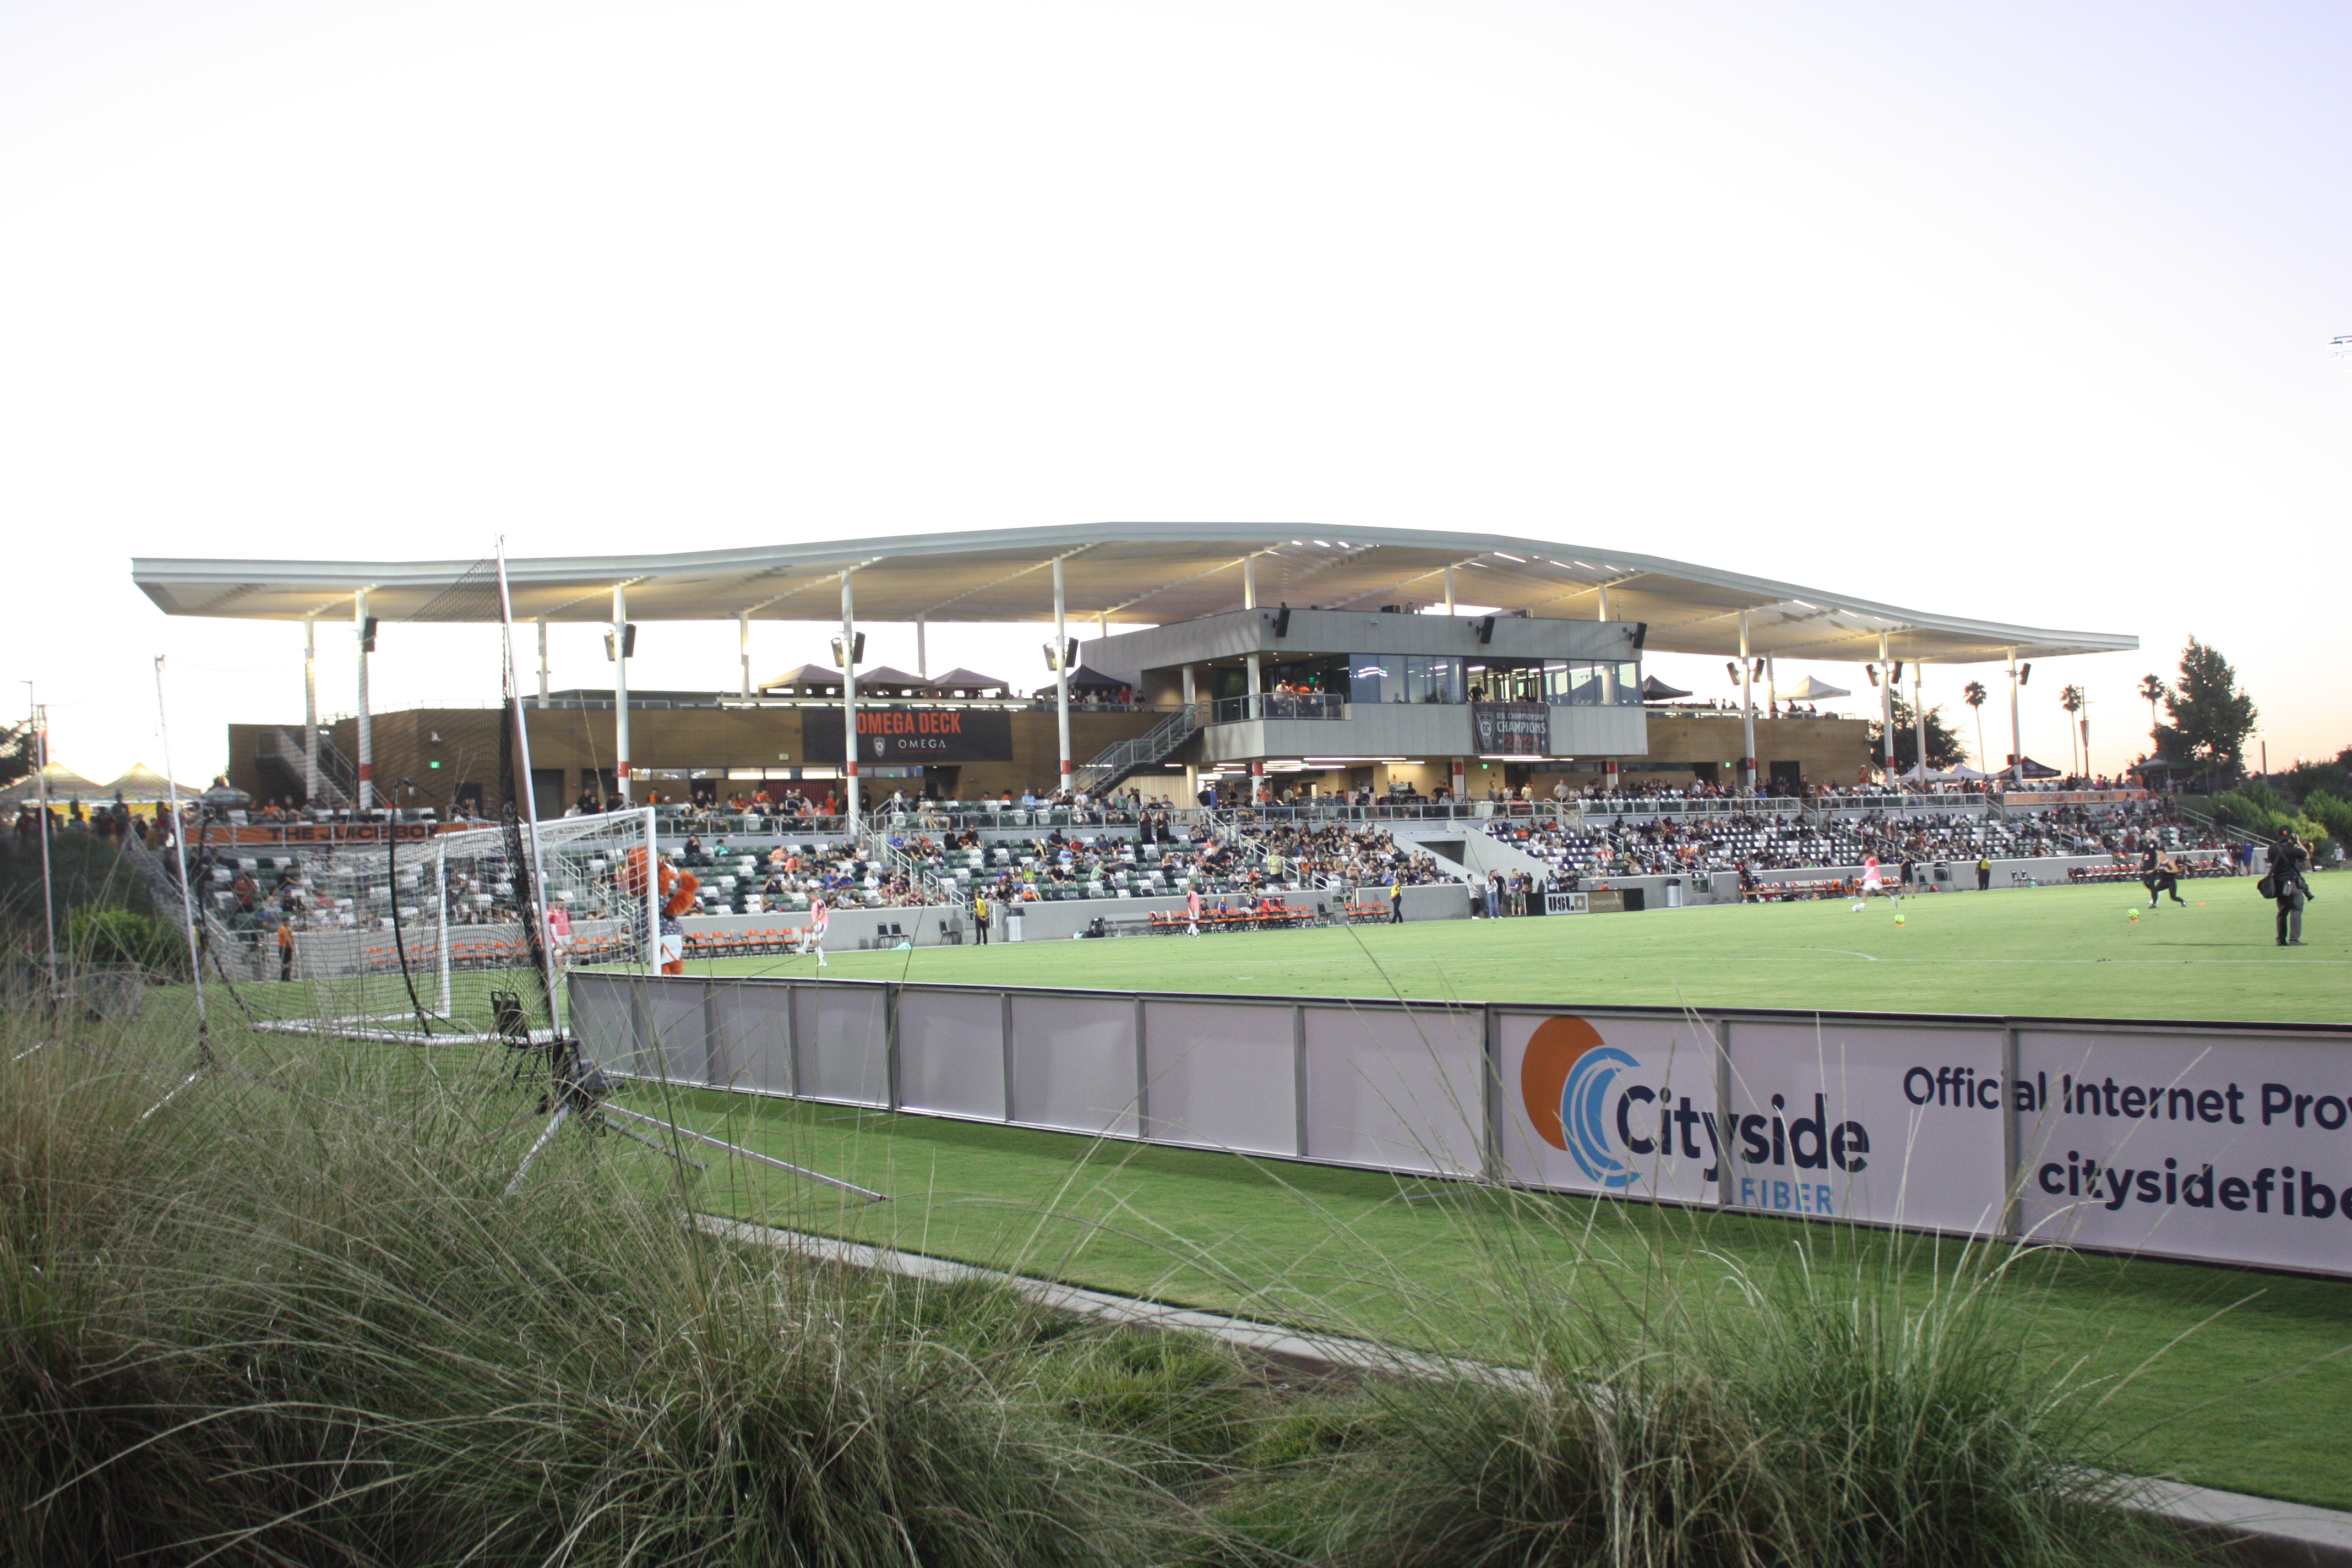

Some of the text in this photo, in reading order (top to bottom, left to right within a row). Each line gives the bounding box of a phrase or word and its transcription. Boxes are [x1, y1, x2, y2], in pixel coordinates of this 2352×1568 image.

[857, 712, 961, 734] OMEGA DECK
[1508, 712, 1545, 721] CHAMPIONSHIP
[1497, 721, 1546, 734] CHAMPIONS
[898, 739, 946, 749] OMEGA
[1505, 734, 1539, 749] 2021
[268, 825, 440, 841] THE JUICE BOX
[1548, 896, 1574, 912] USL
[1903, 1066, 2352, 1130] Offical Internet Pro
[1616, 1085, 1870, 1182] Cityside
[1741, 1178, 1833, 1215] FIBER
